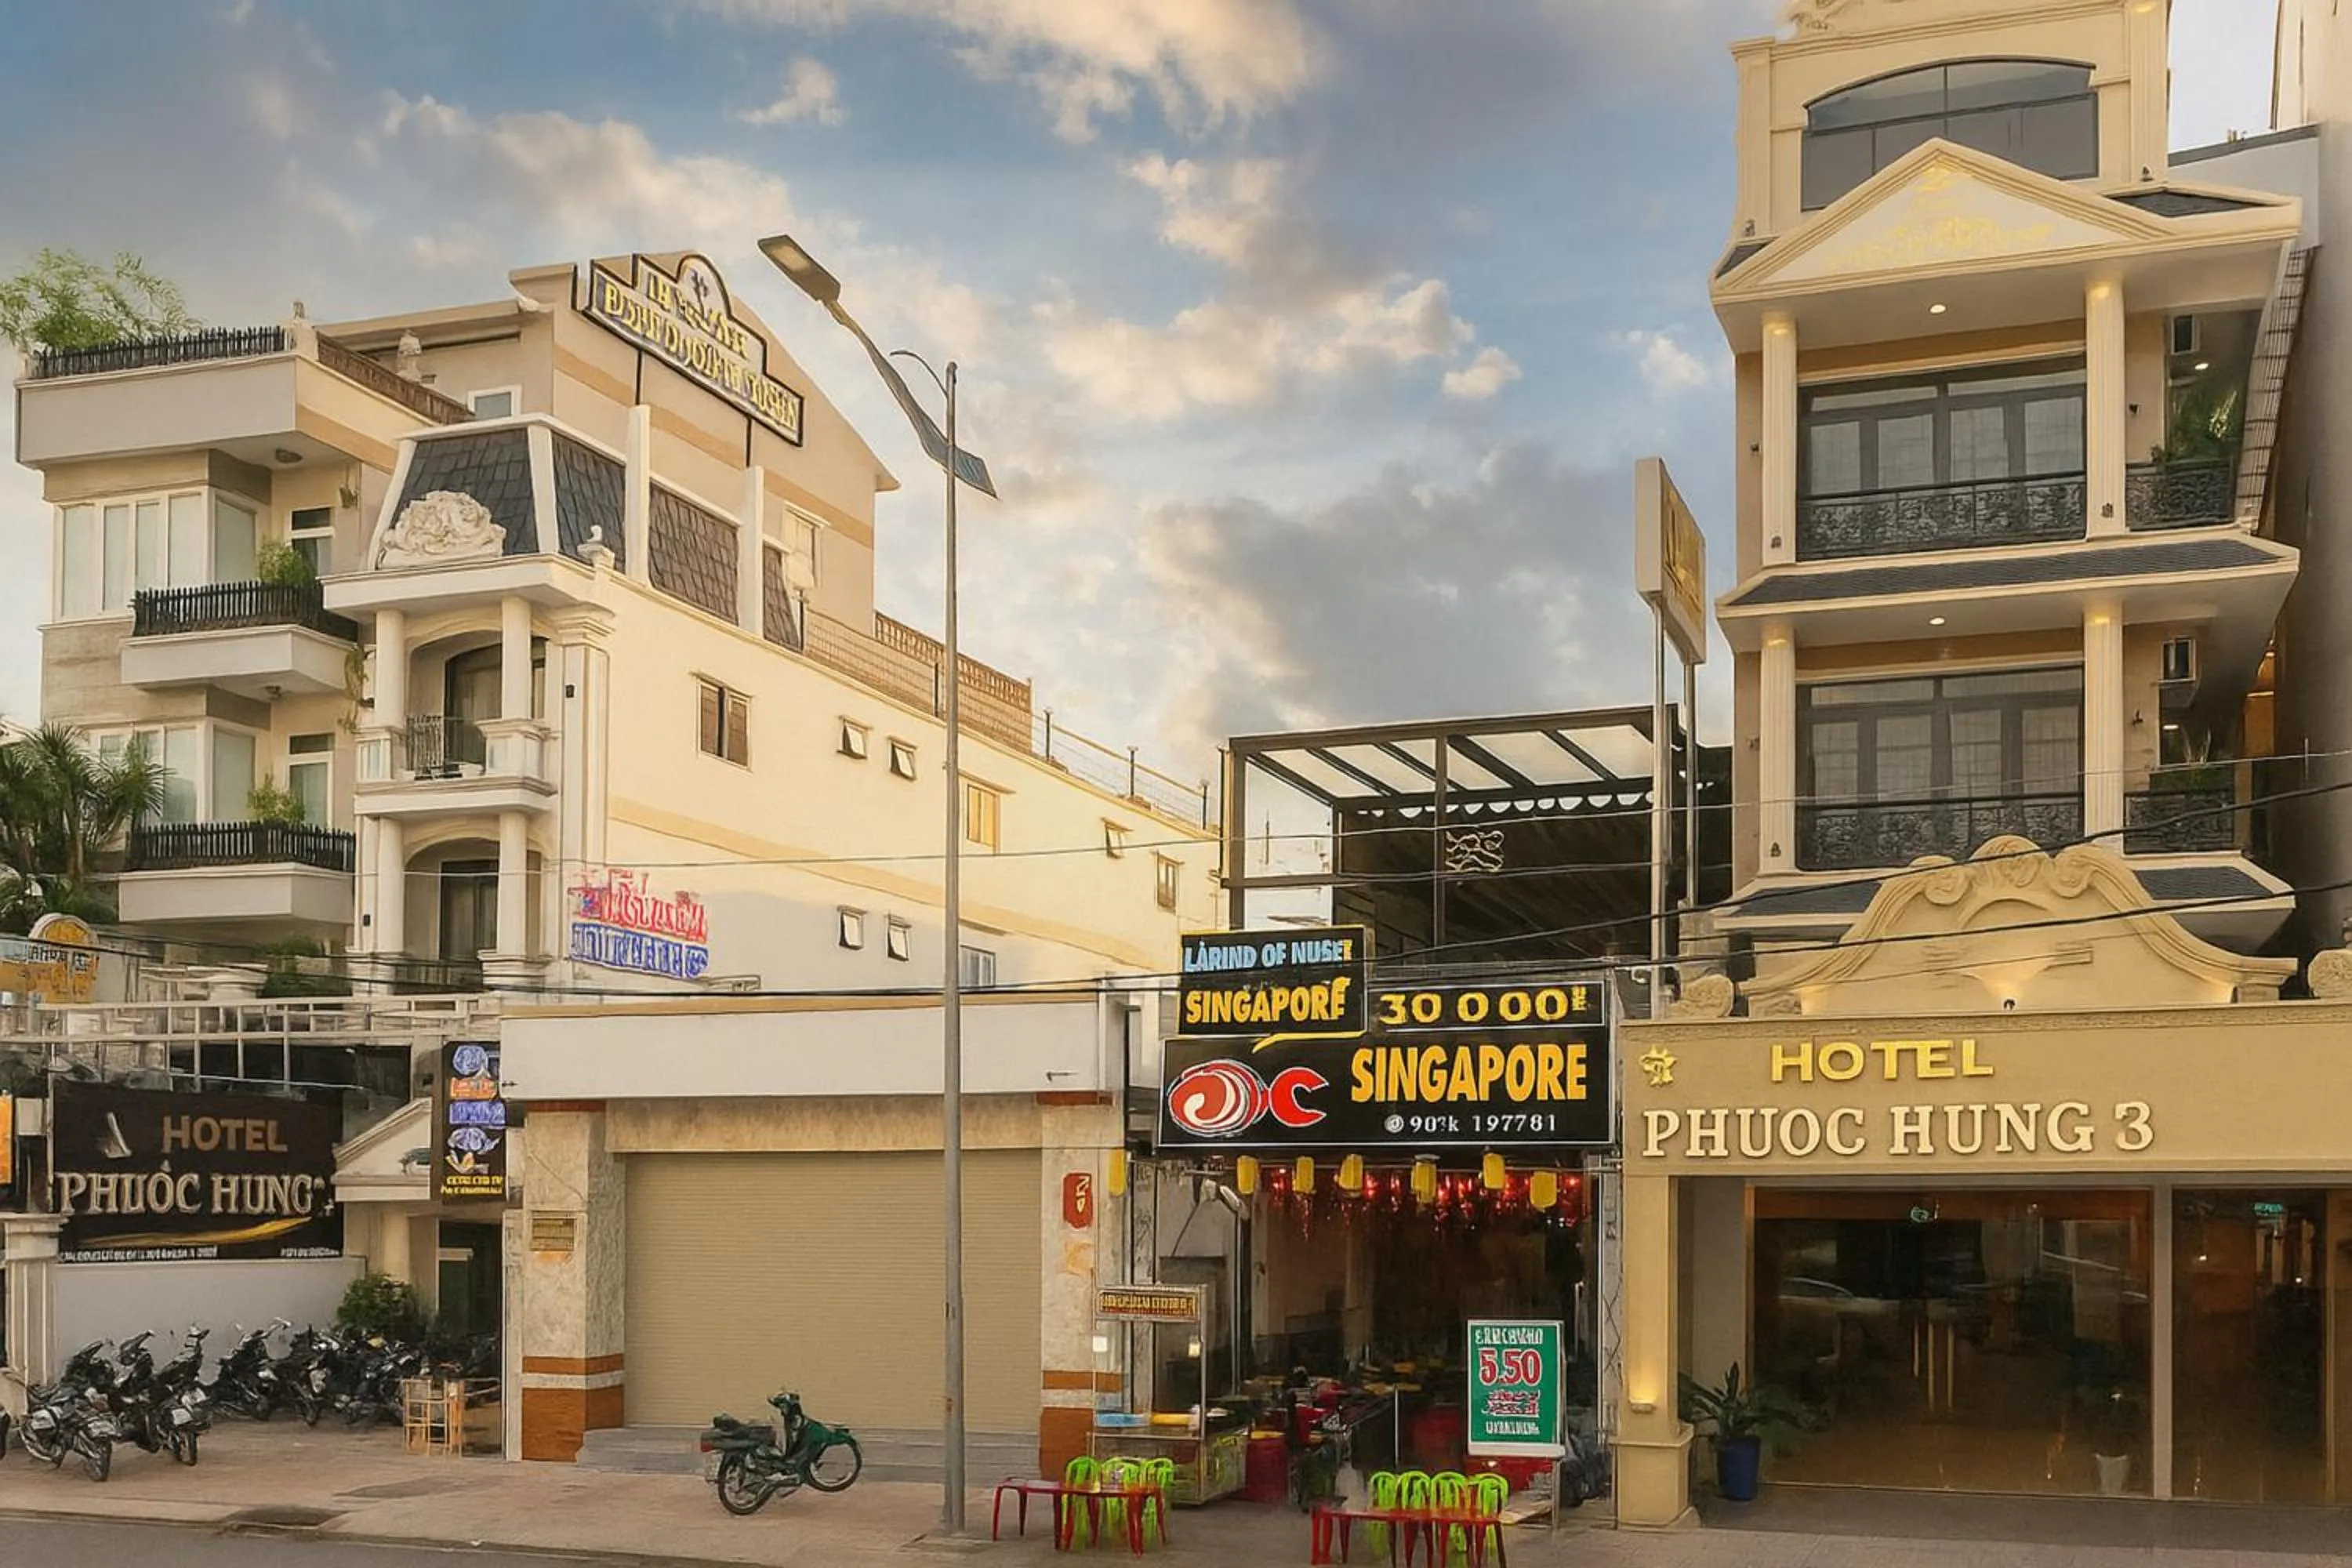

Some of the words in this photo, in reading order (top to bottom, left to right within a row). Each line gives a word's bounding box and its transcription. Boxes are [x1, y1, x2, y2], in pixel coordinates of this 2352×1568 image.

[1261, 942, 1287, 967] OF
[1351, 1044, 1588, 1102] SINGAPORE
[1771, 1039, 1994, 1082] HOTEL
[160, 1115, 289, 1153] HOTEL
[1472, 1113, 1556, 1132] 197781
[1642, 1107, 1866, 1158] PHUOC
[1888, 1102, 2095, 1156] HUNG
[2114, 1102, 2154, 1151] 3
